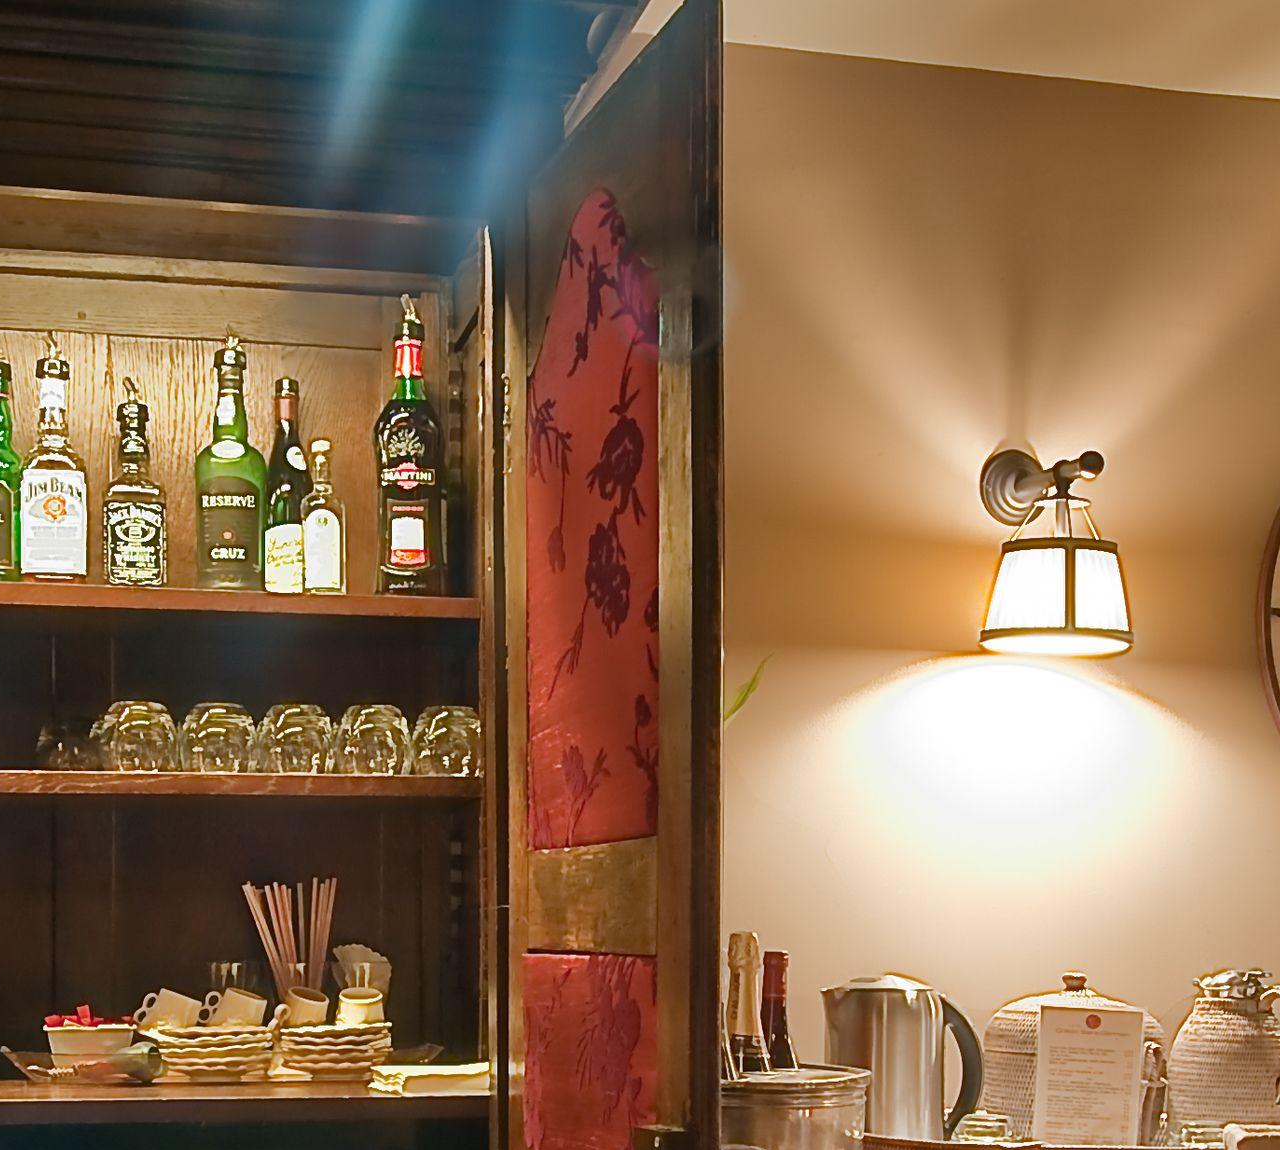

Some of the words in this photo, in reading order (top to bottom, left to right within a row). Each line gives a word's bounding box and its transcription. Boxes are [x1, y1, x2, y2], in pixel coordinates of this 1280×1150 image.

[383, 470, 433, 482] MARTINI
[25, 481, 48, 503] JIM
[201, 494, 256, 509] RESERVE
[210, 547, 246, 560] CRUZ
